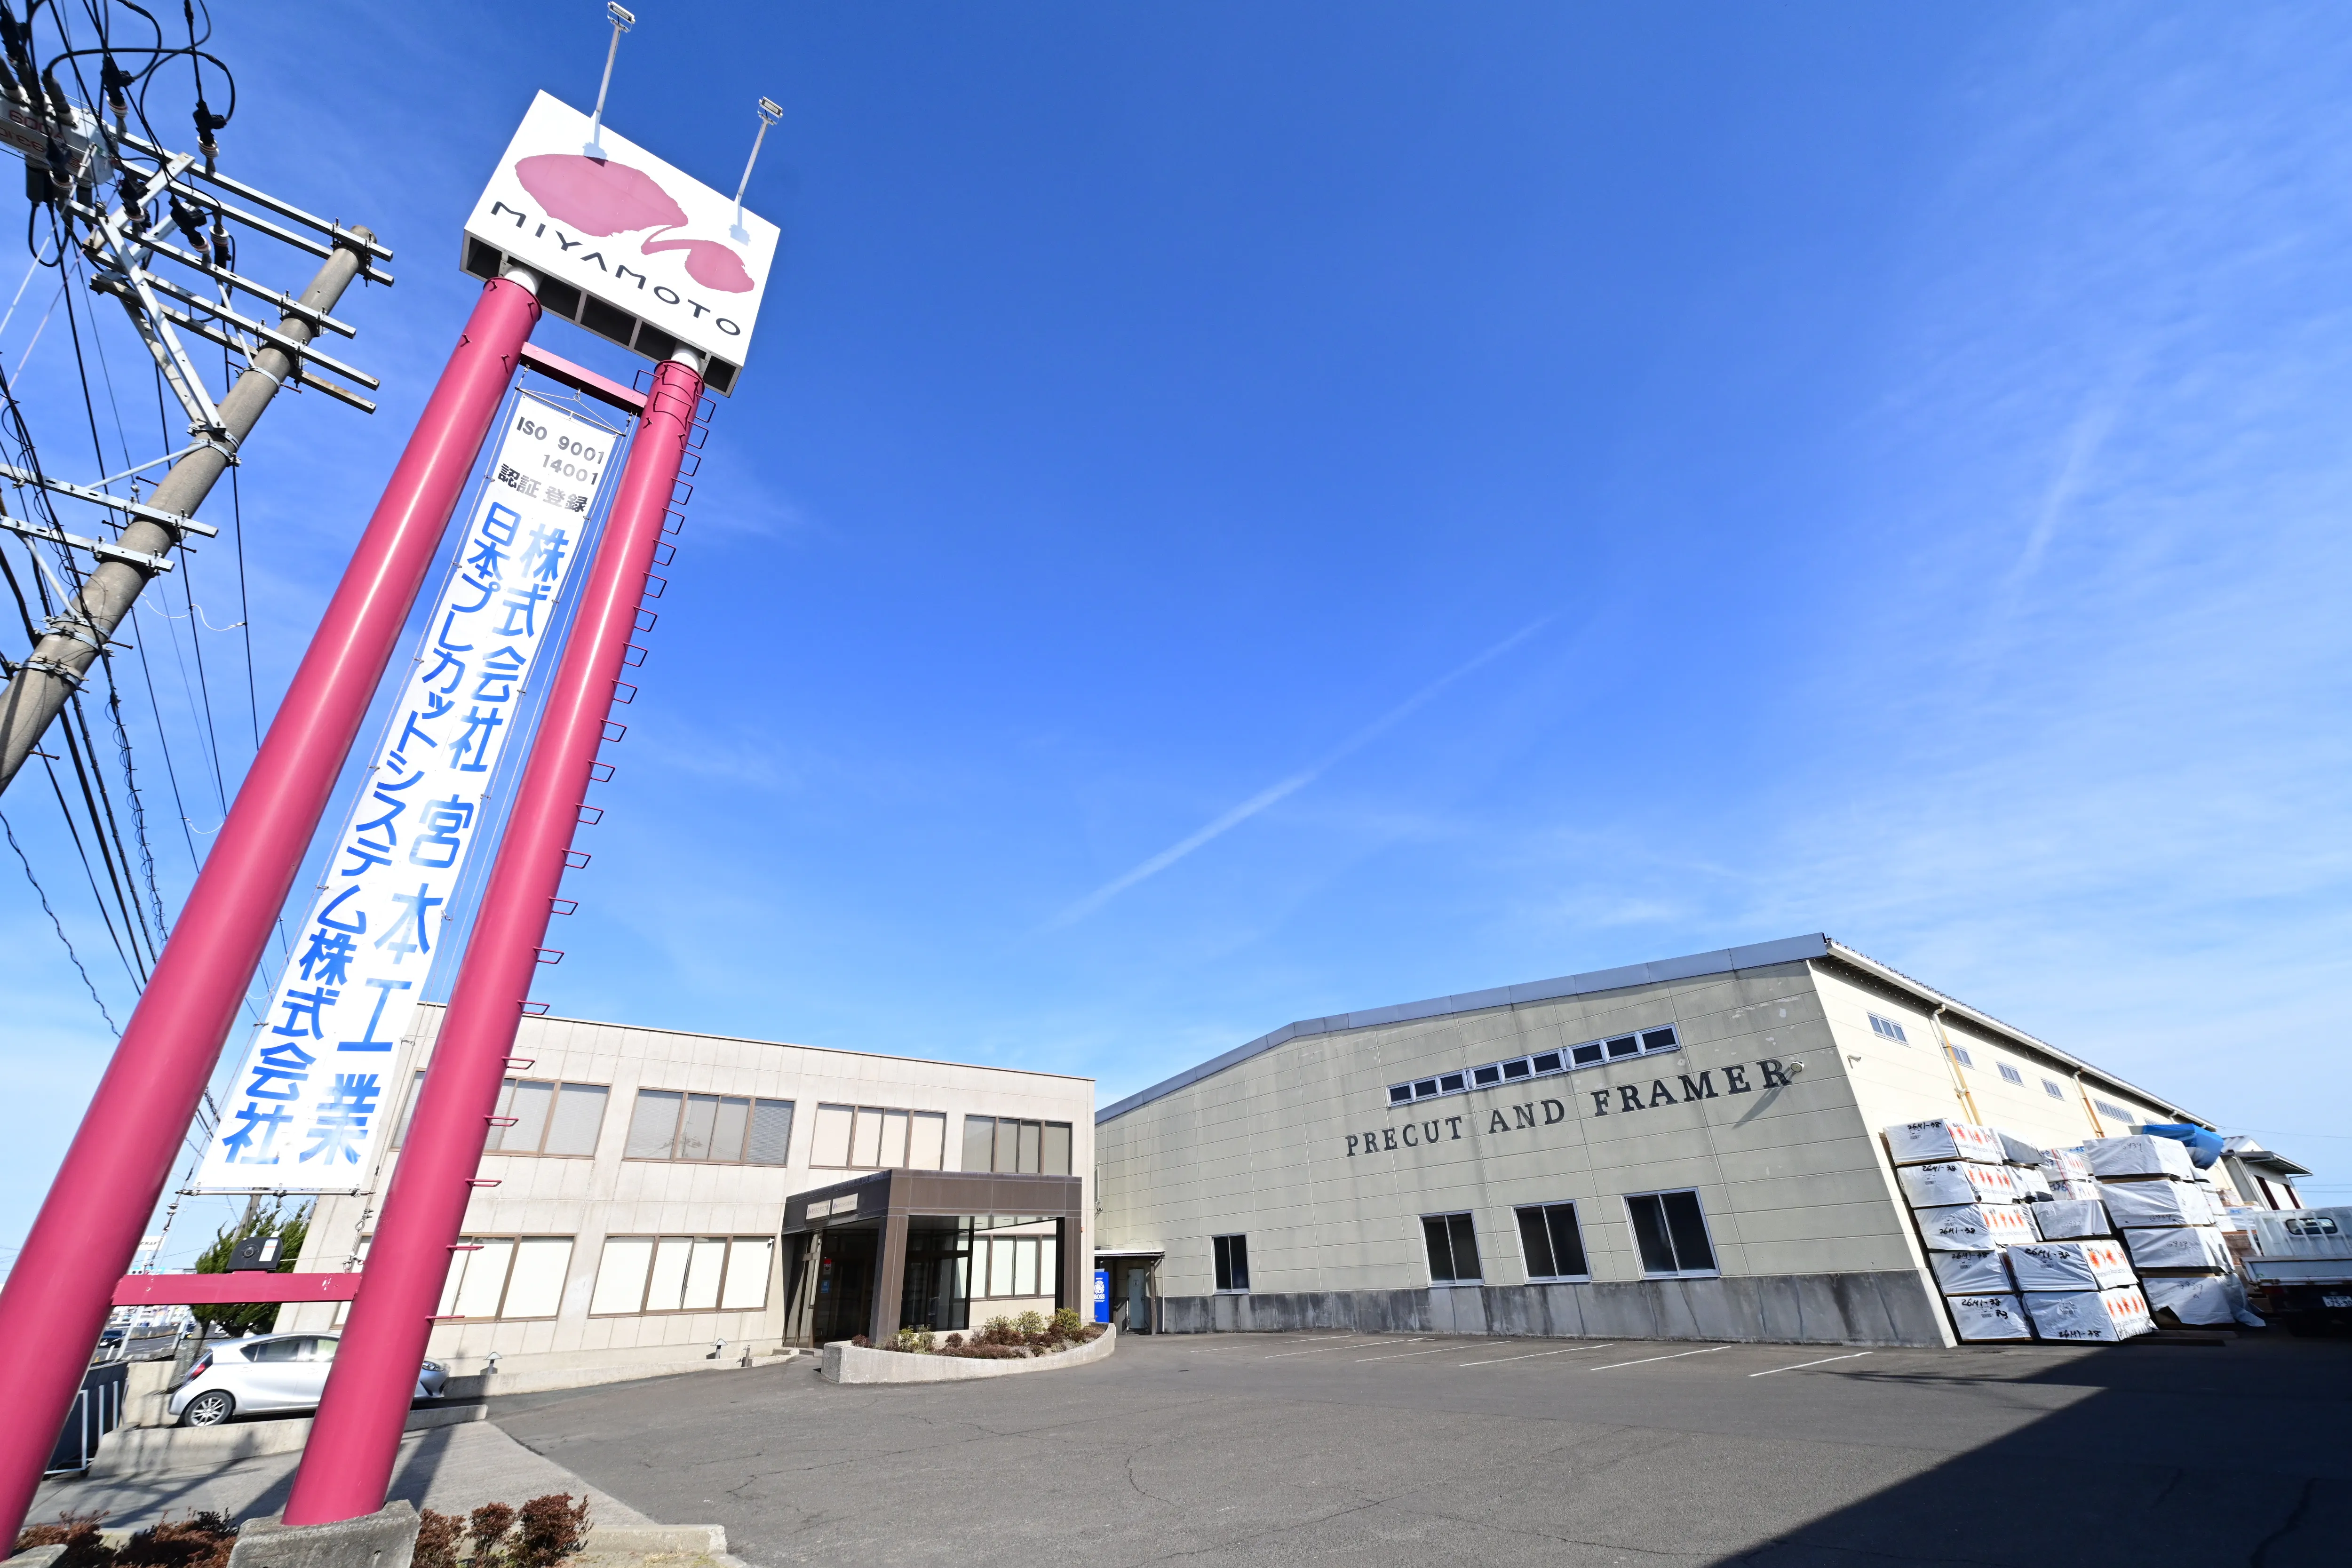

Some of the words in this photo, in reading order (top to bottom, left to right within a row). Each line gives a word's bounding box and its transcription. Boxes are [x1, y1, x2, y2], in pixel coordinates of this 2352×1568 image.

[491, 201, 741, 336] MIYAMOTO
[516, 416, 548, 441] ISO
[557, 436, 604, 465] 9001
[542, 454, 599, 486] 14001
[1345, 1116, 1462, 1157] PRECUT
[1488, 1099, 1565, 1134] AND
[1590, 1059, 1791, 1117] FRAMER
